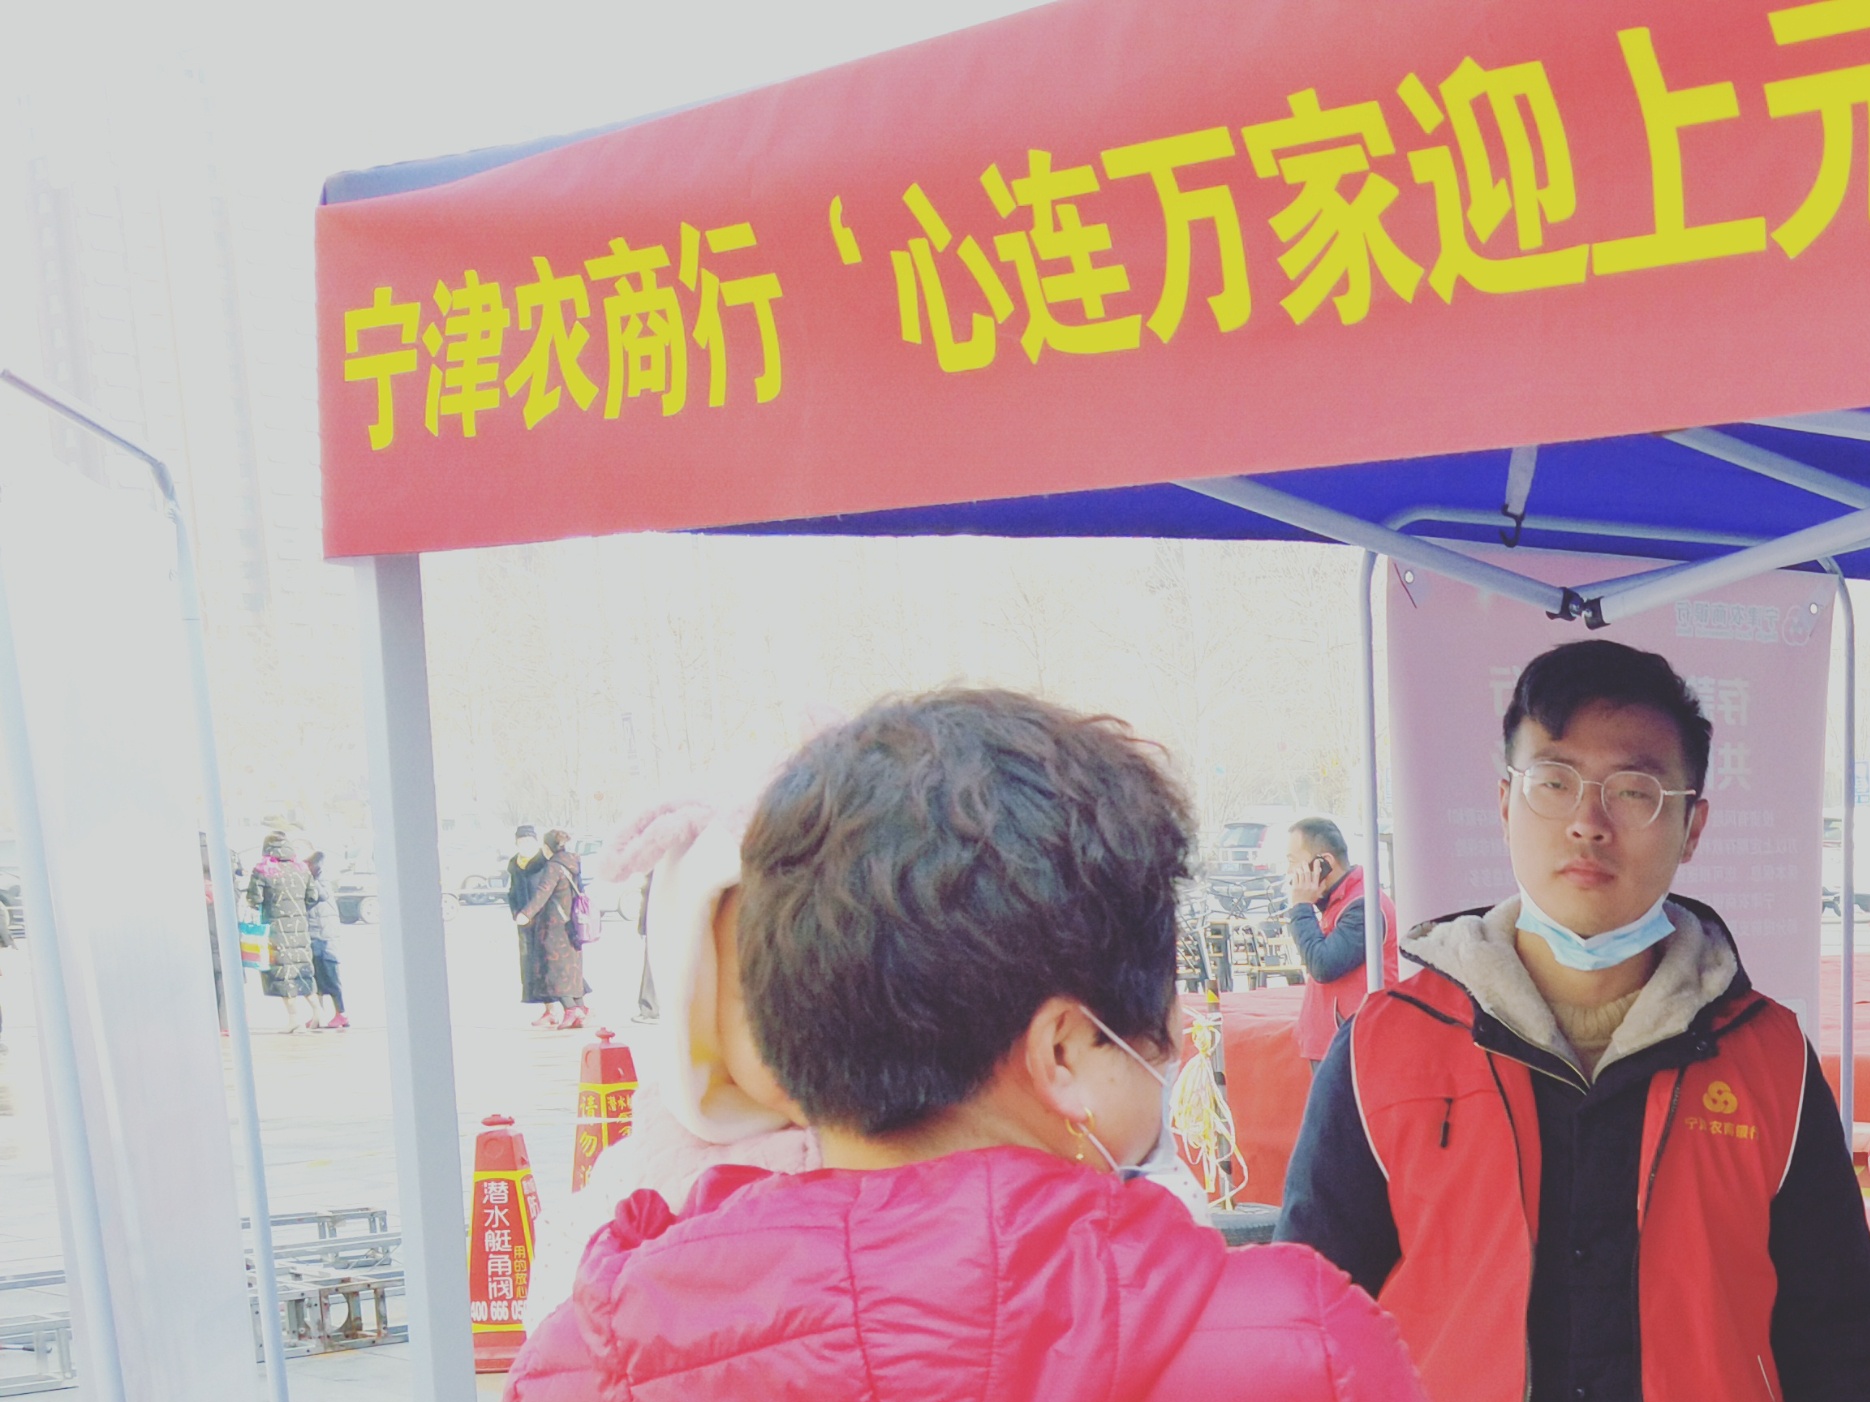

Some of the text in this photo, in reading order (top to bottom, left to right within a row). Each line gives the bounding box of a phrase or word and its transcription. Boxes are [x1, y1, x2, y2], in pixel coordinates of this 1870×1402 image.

[344, 221, 784, 452] 宁津农商行
[482, 1181, 514, 1300] 潜水艇角阀
